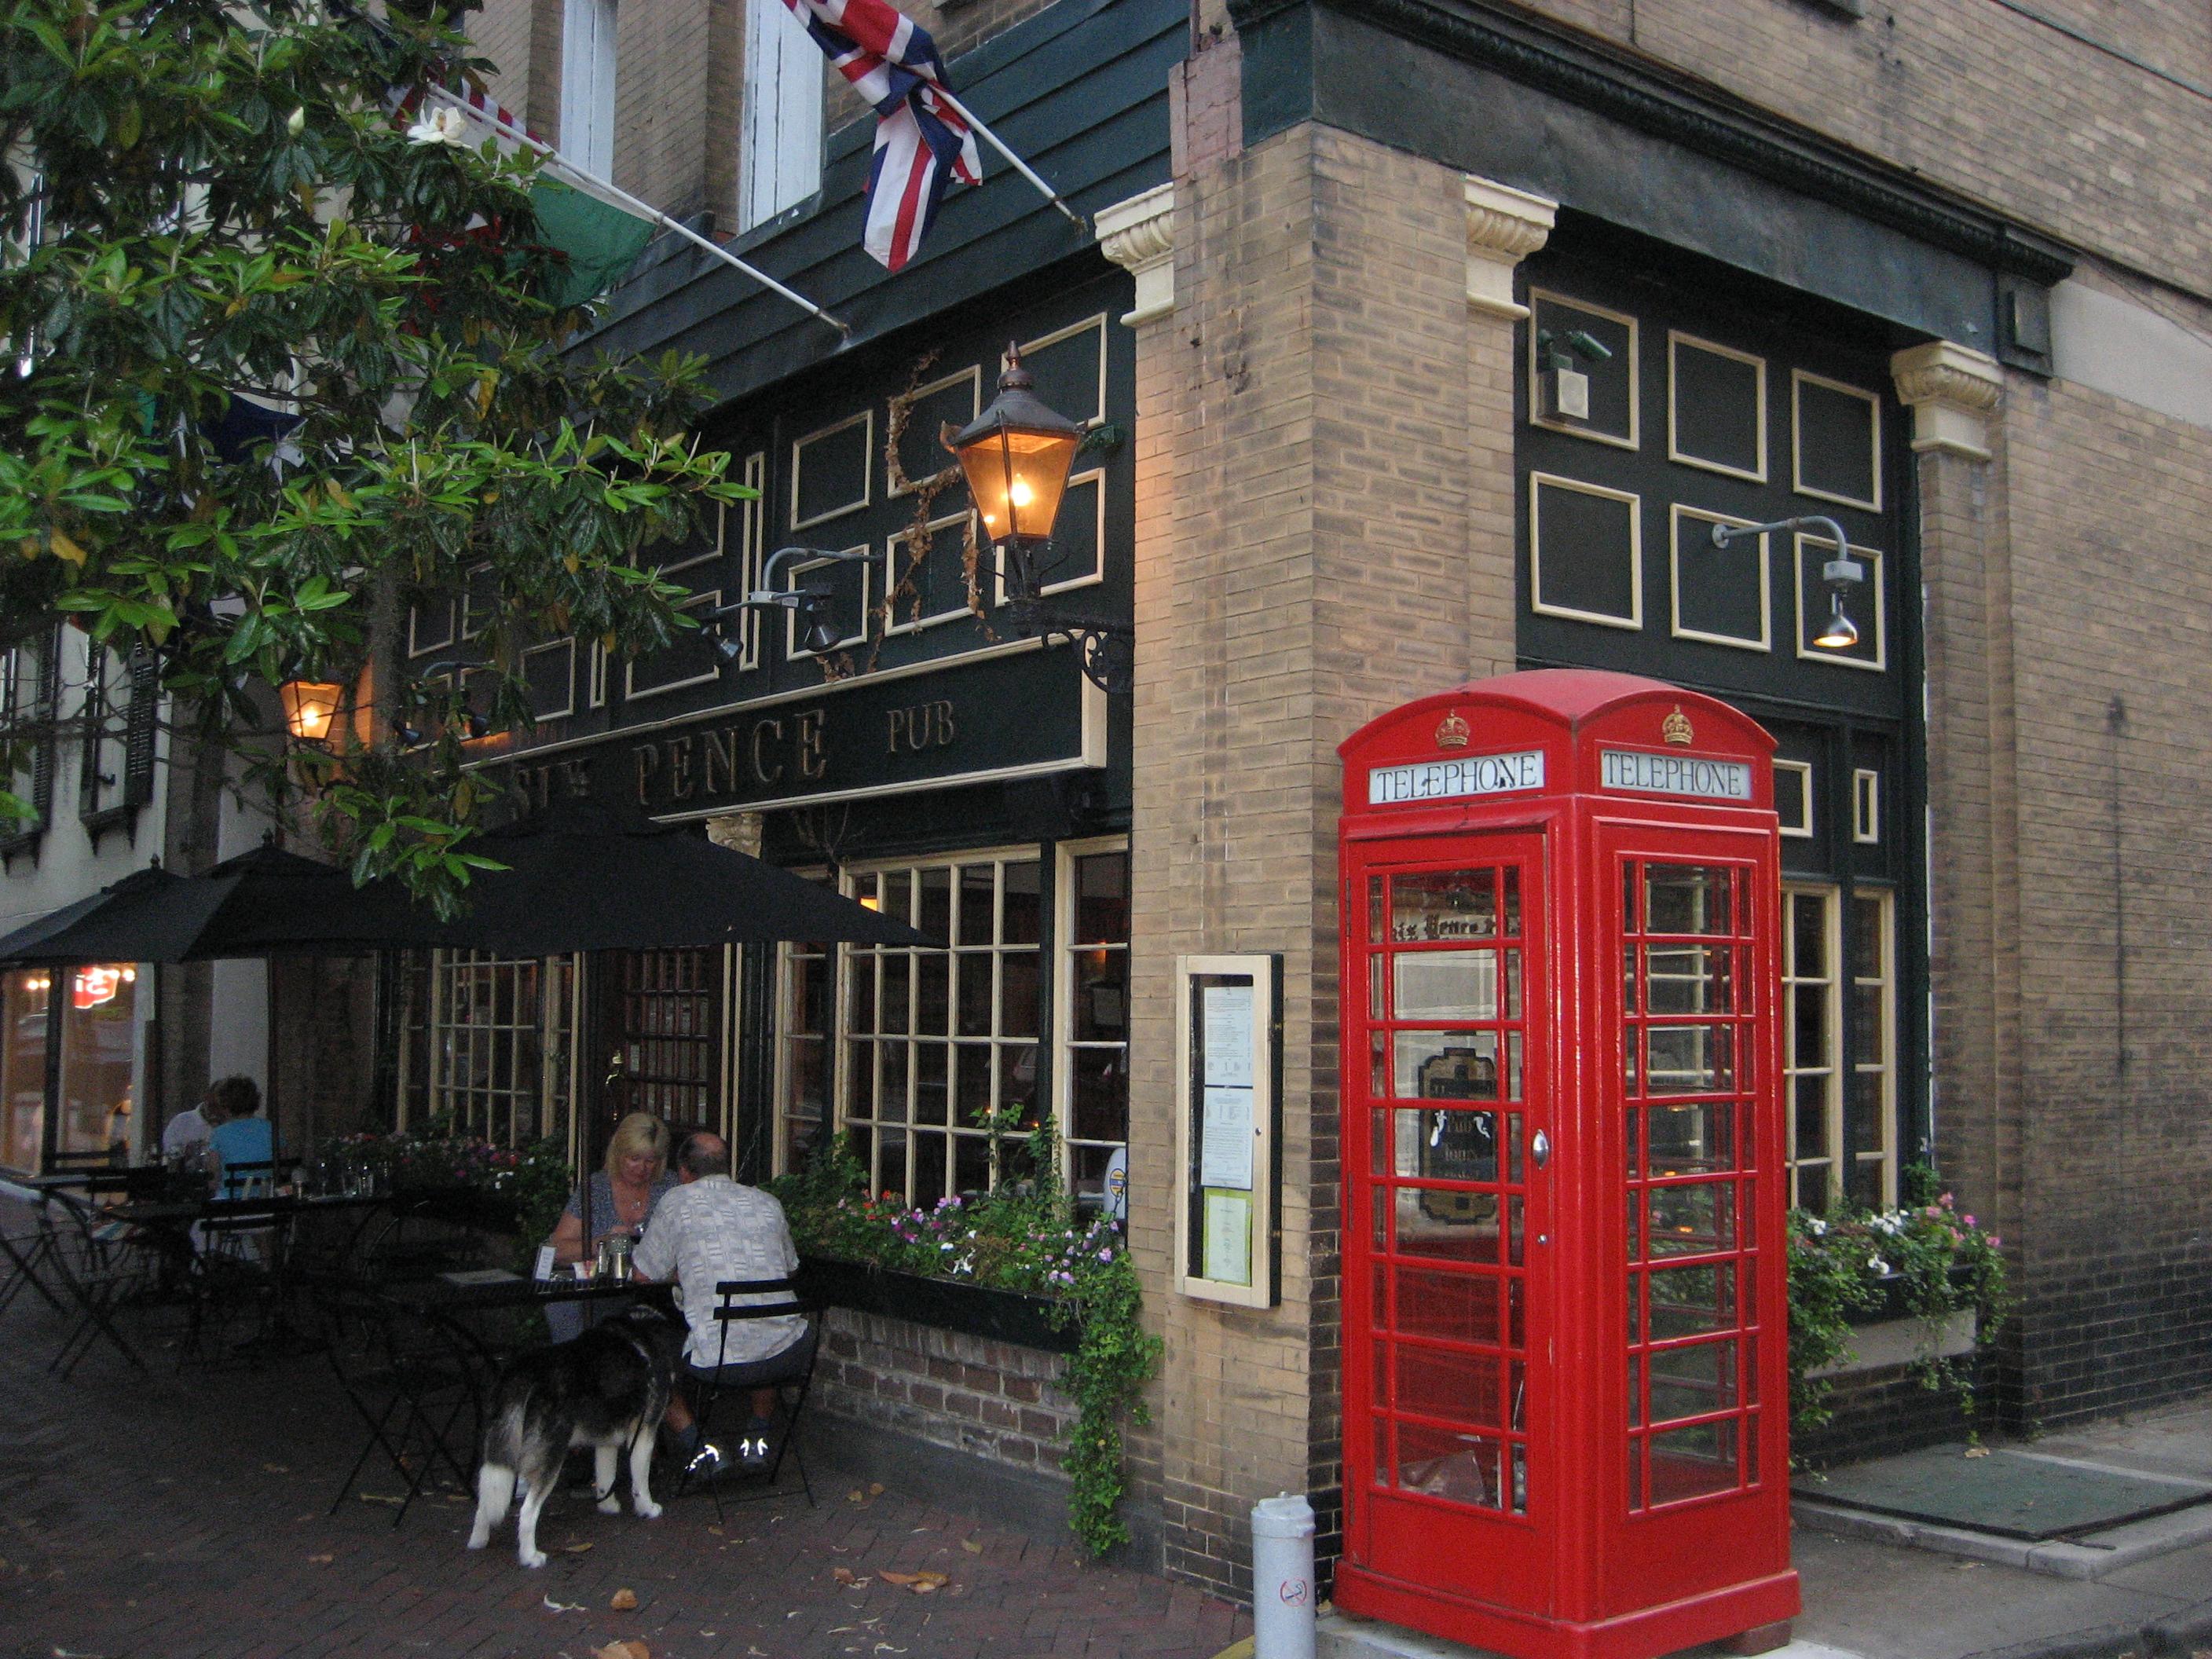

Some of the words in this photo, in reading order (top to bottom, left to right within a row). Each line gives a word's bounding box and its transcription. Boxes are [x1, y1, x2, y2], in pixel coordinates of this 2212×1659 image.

[633, 709, 827, 806] PENCE
[886, 700, 955, 753] PUB
[1603, 751, 1741, 796] TELEPHONE
[1375, 754, 1537, 802] TELEPHONE
